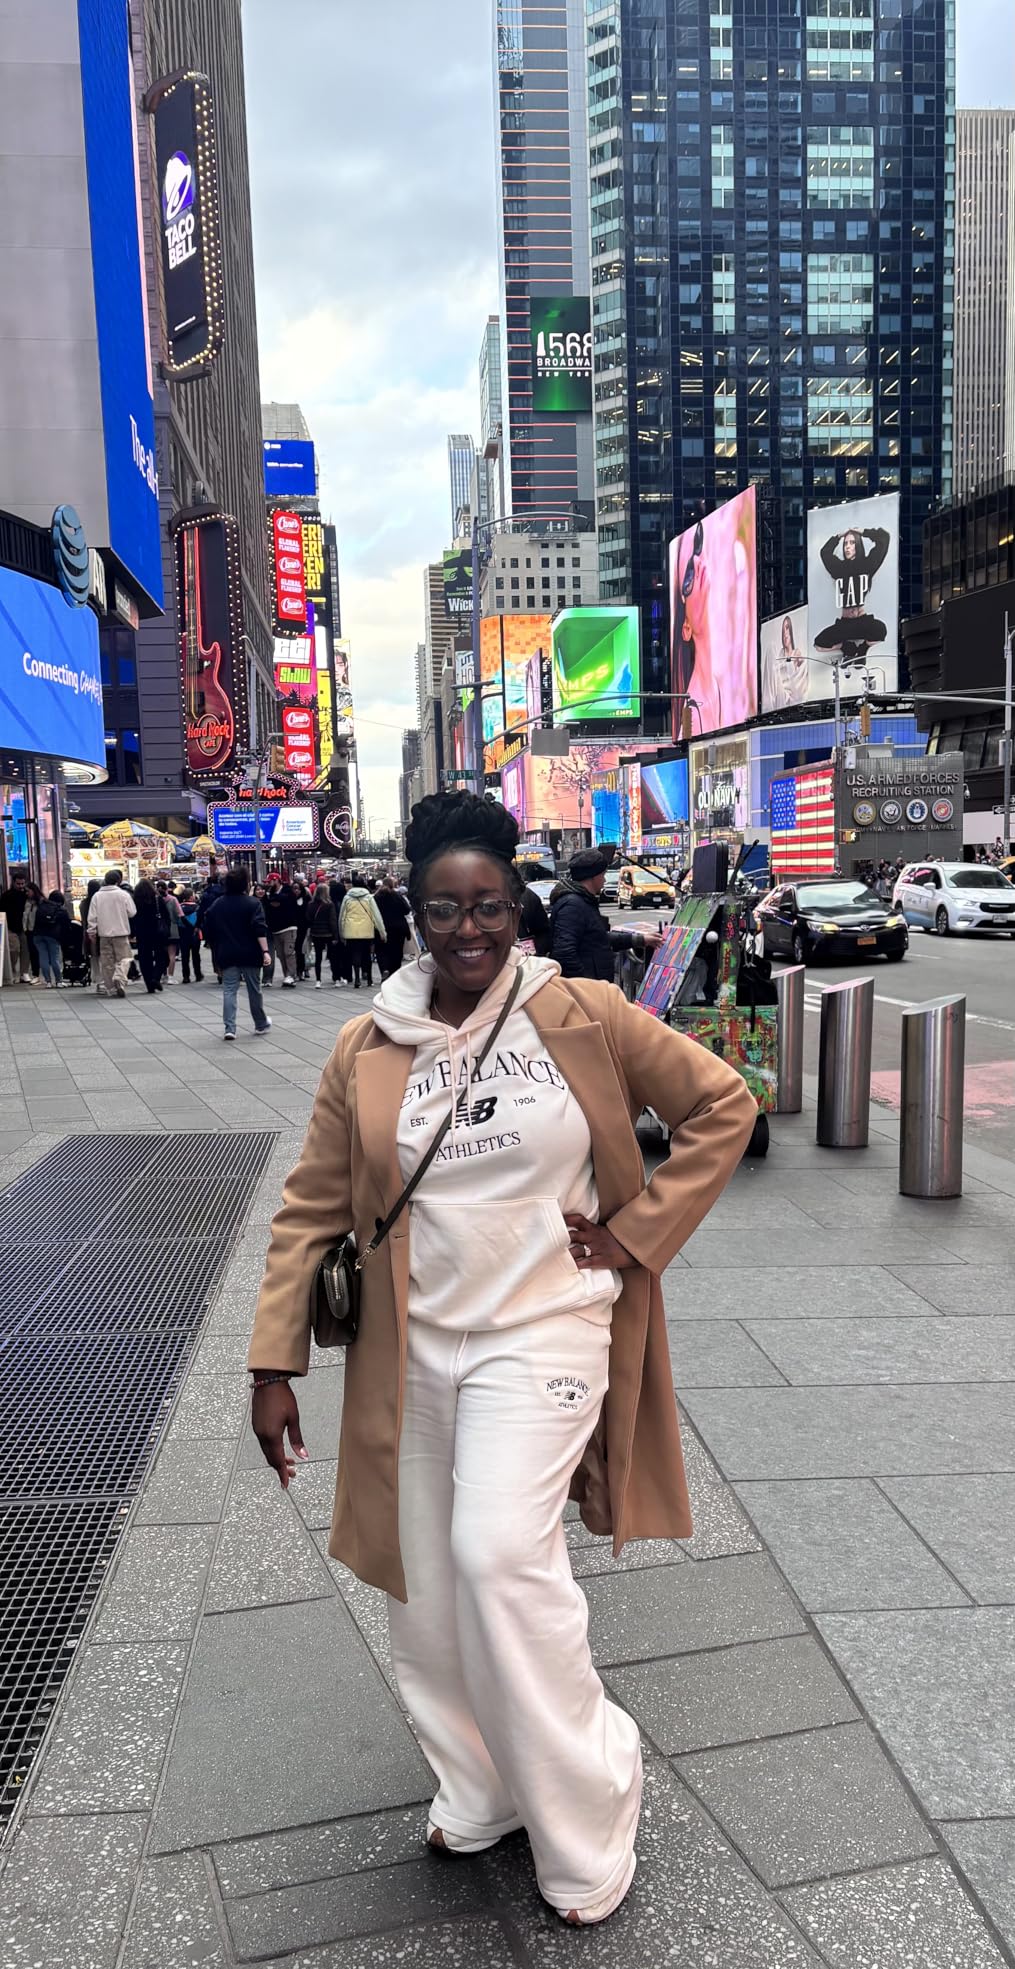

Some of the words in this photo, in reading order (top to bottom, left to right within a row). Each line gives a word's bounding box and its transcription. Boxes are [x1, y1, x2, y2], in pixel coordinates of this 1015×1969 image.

[165, 213, 195, 249] TACO
[169, 235, 197, 270] BELL
[130, 414, 146, 478] The
[835, 574, 869, 609] GAP
[22, 651, 79, 695] Connecting
[187, 722, 208, 739] Hard
[208, 720, 231, 739] Rock
[448, 770, 455, 780] W
[847, 774, 867, 786] U.S.
[868, 773, 911, 785] ARMED
[913, 772, 960, 784] FORCES
[714, 787, 737, 807] NAVY
[852, 786, 912, 798] RECRUITING
[913, 785, 955, 796] STATION
[513, 1095, 536, 1108] 1906
[410, 1117, 429, 1129] EST.
[435, 1131, 522, 1162] ATHLETICS
[546, 1377, 563, 1391] NEW
[564, 1377, 590, 1396] BALANCE
